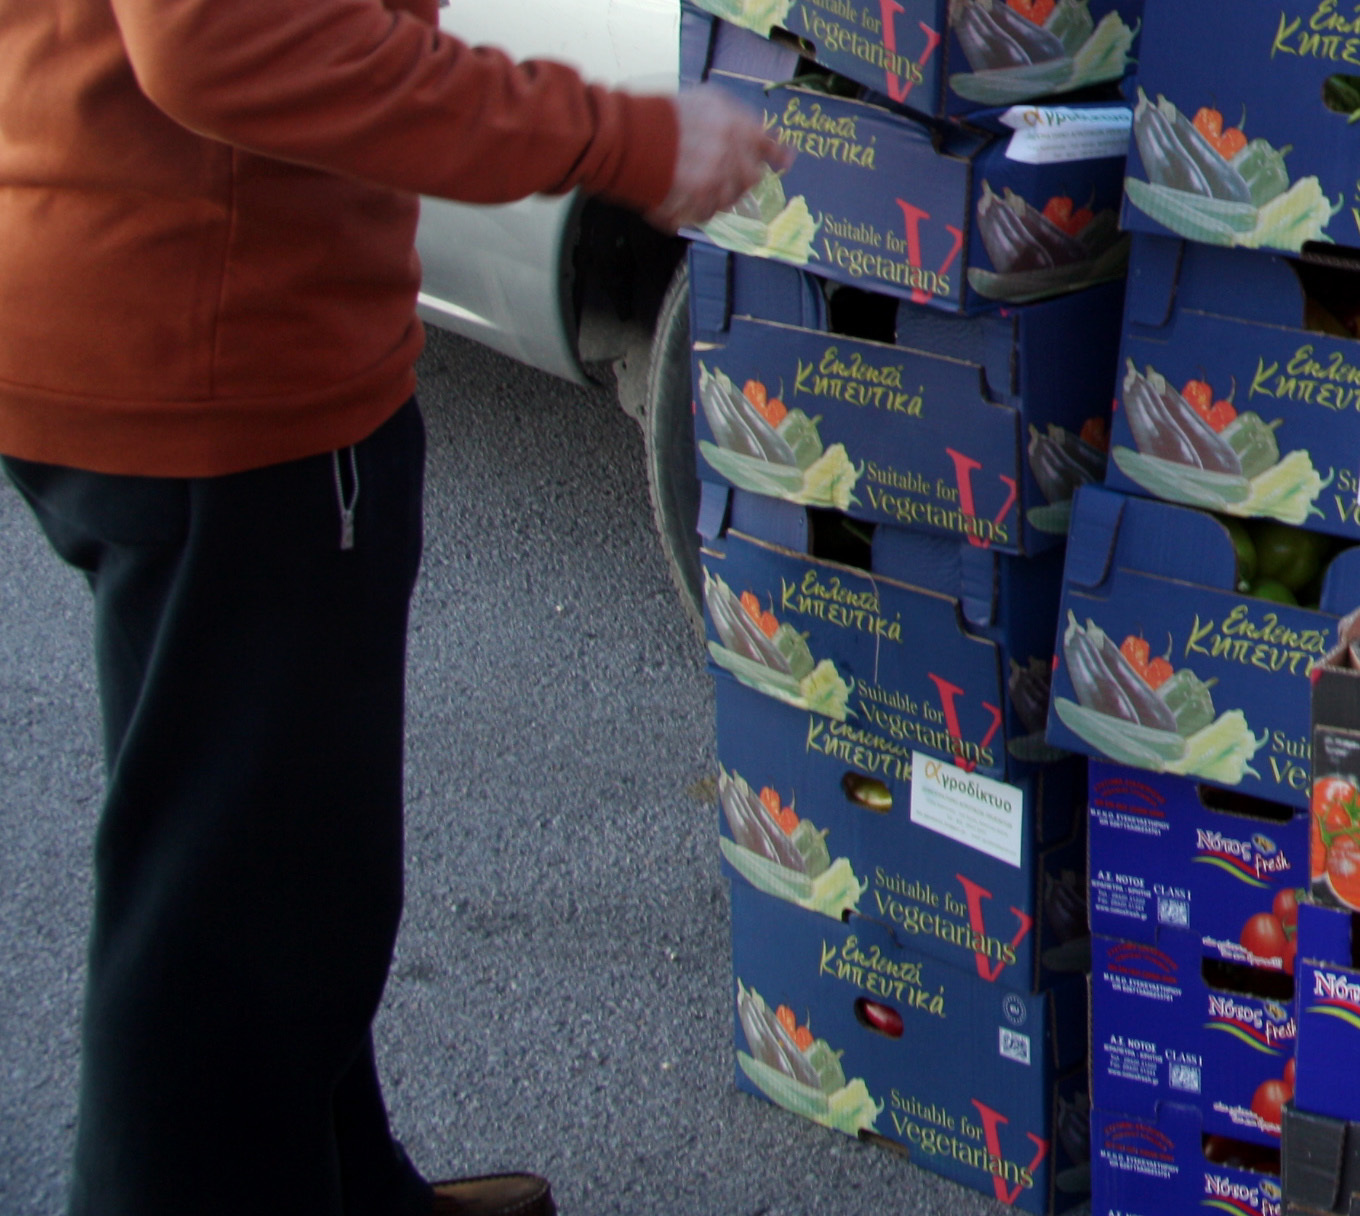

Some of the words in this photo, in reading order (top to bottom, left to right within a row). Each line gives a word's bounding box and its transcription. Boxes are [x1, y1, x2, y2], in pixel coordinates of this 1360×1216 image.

[861, 7, 883, 36] for
[801, 5, 924, 85] Vegetarians
[824, 215, 882, 249] Suitable
[885, 233, 908, 252] for
[823, 238, 951, 296] Vegetarians
[867, 459, 931, 496] Suitable
[935, 479, 959, 501] for
[865, 485, 1008, 544] Vegetarians
[857, 678, 918, 715] Suitable
[921, 699, 945, 723] for
[857, 702, 995, 767] Vegetarians
[924, 760, 1013, 815] αγροδίκτυο
[1196, 827, 1252, 862] Νότος
[1254, 850, 1291, 879] fresh
[874, 867, 941, 910] Suitable
[943, 891, 967, 918] for
[1153, 883, 1186, 899] CLASS
[873, 889, 1017, 966] Vegetarians
[1208, 994, 1263, 1029] Νότος
[1165, 1048, 1198, 1065] CLASS
[889, 1088, 955, 1129] Suitable
[959, 1112, 983, 1141] for
[888, 1112, 1034, 1190] Vegetarians
[1204, 1172, 1259, 1207] Νότος
